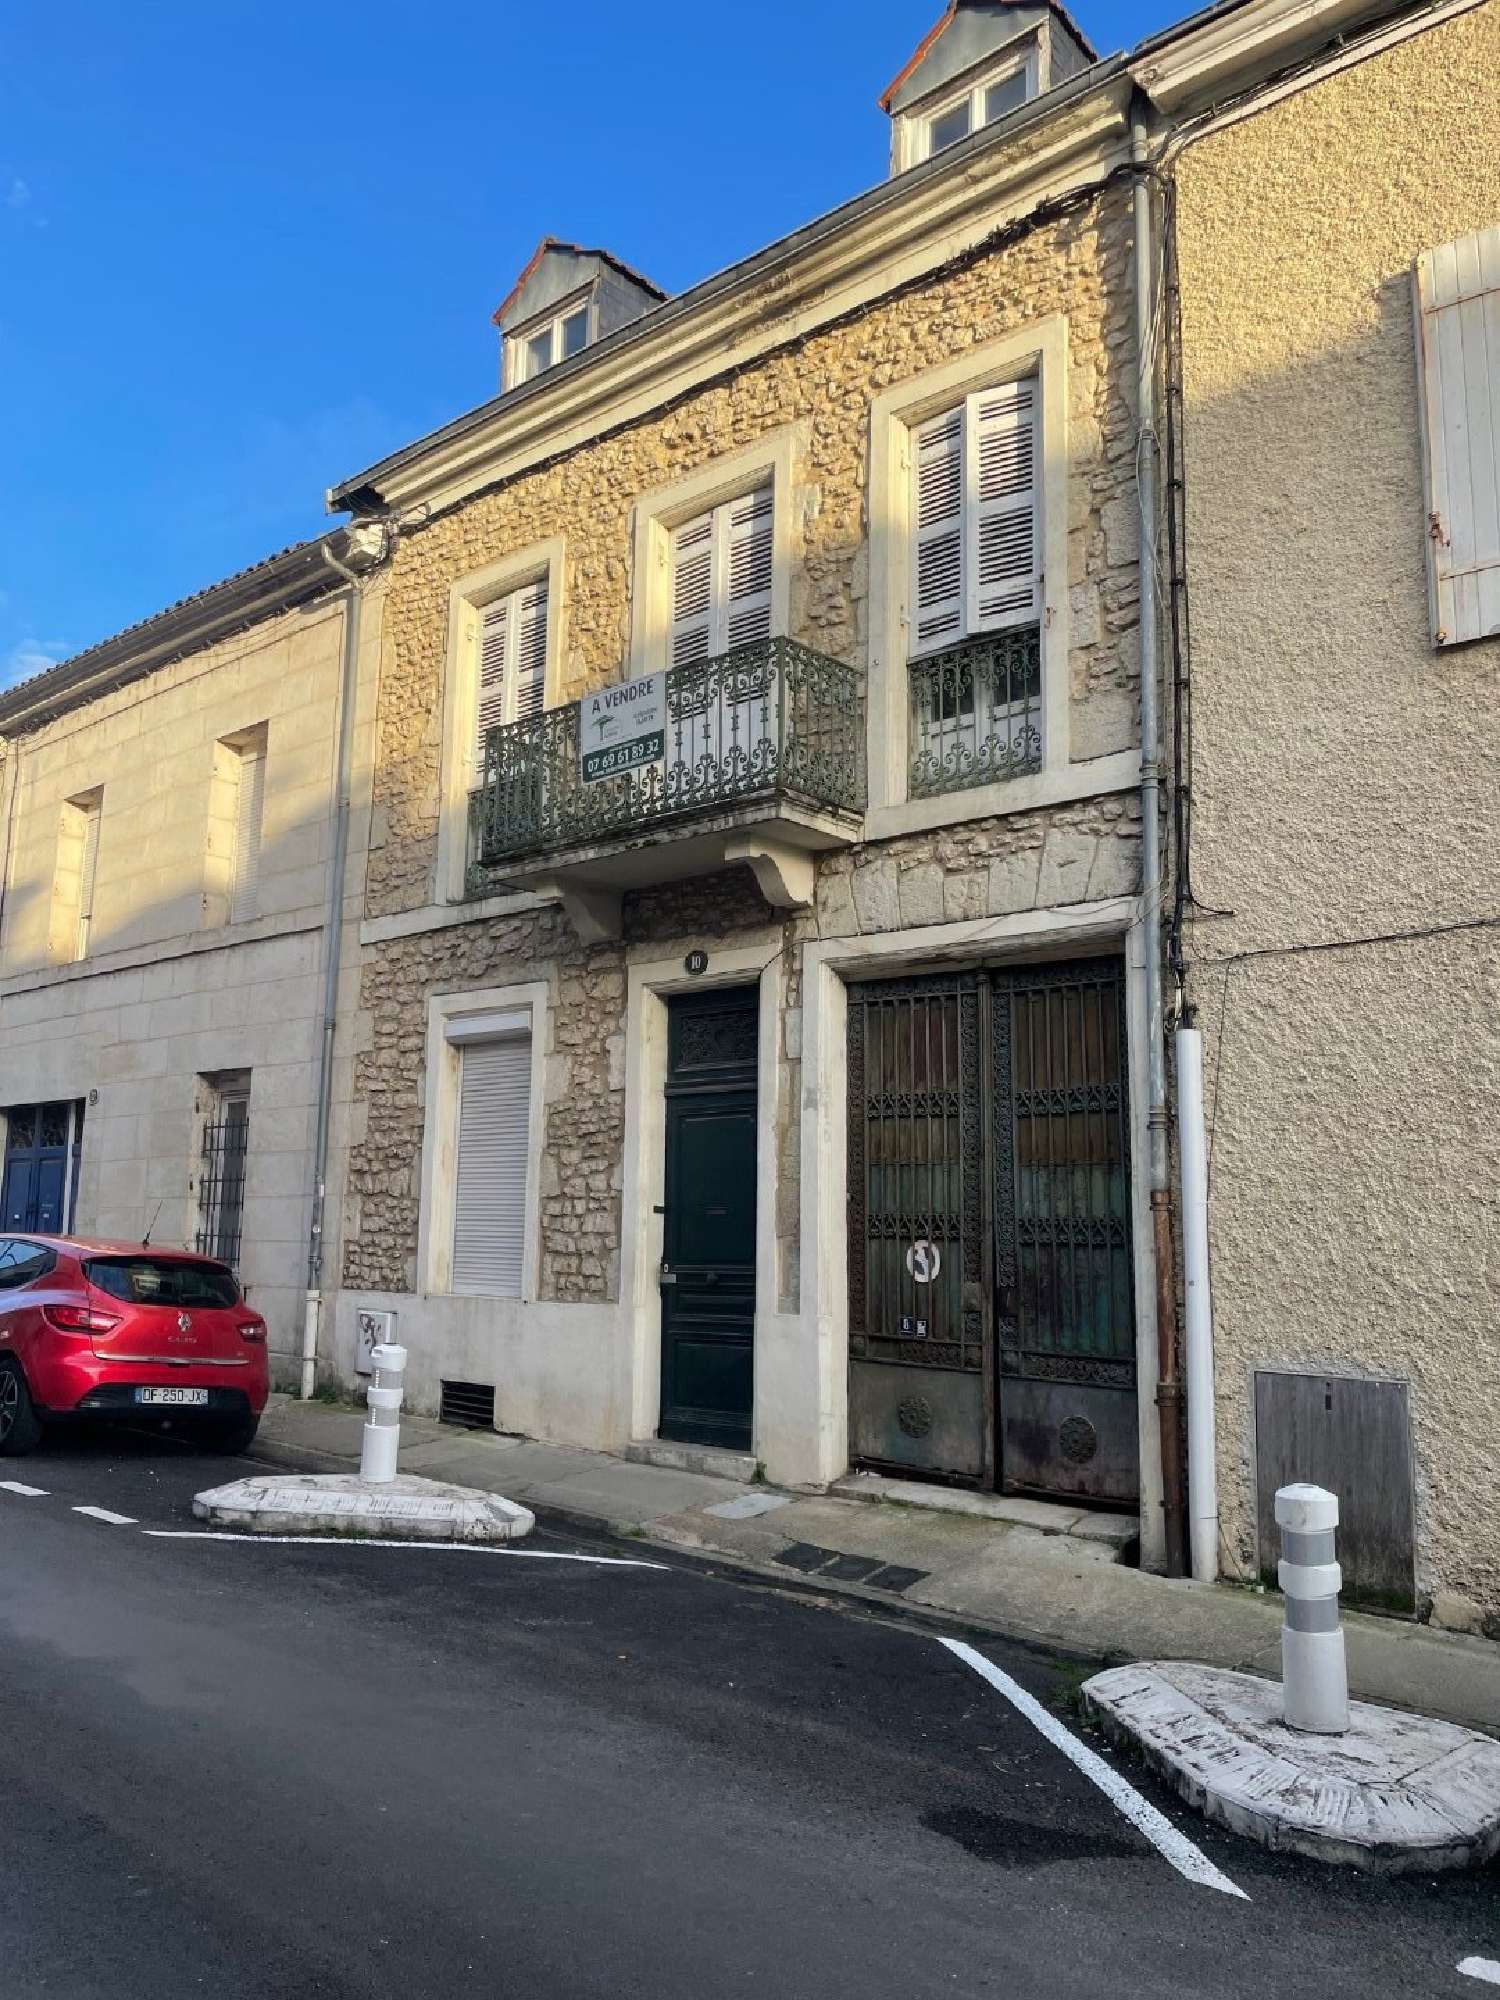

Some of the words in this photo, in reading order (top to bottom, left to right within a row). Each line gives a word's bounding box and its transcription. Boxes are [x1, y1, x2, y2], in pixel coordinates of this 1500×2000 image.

[605, 679, 654, 708] VENDRE
[617, 749, 629, 764] 61
[632, 743, 644, 758] 89
[646, 739, 659, 753] 32
[691, 955, 701, 969] 10
